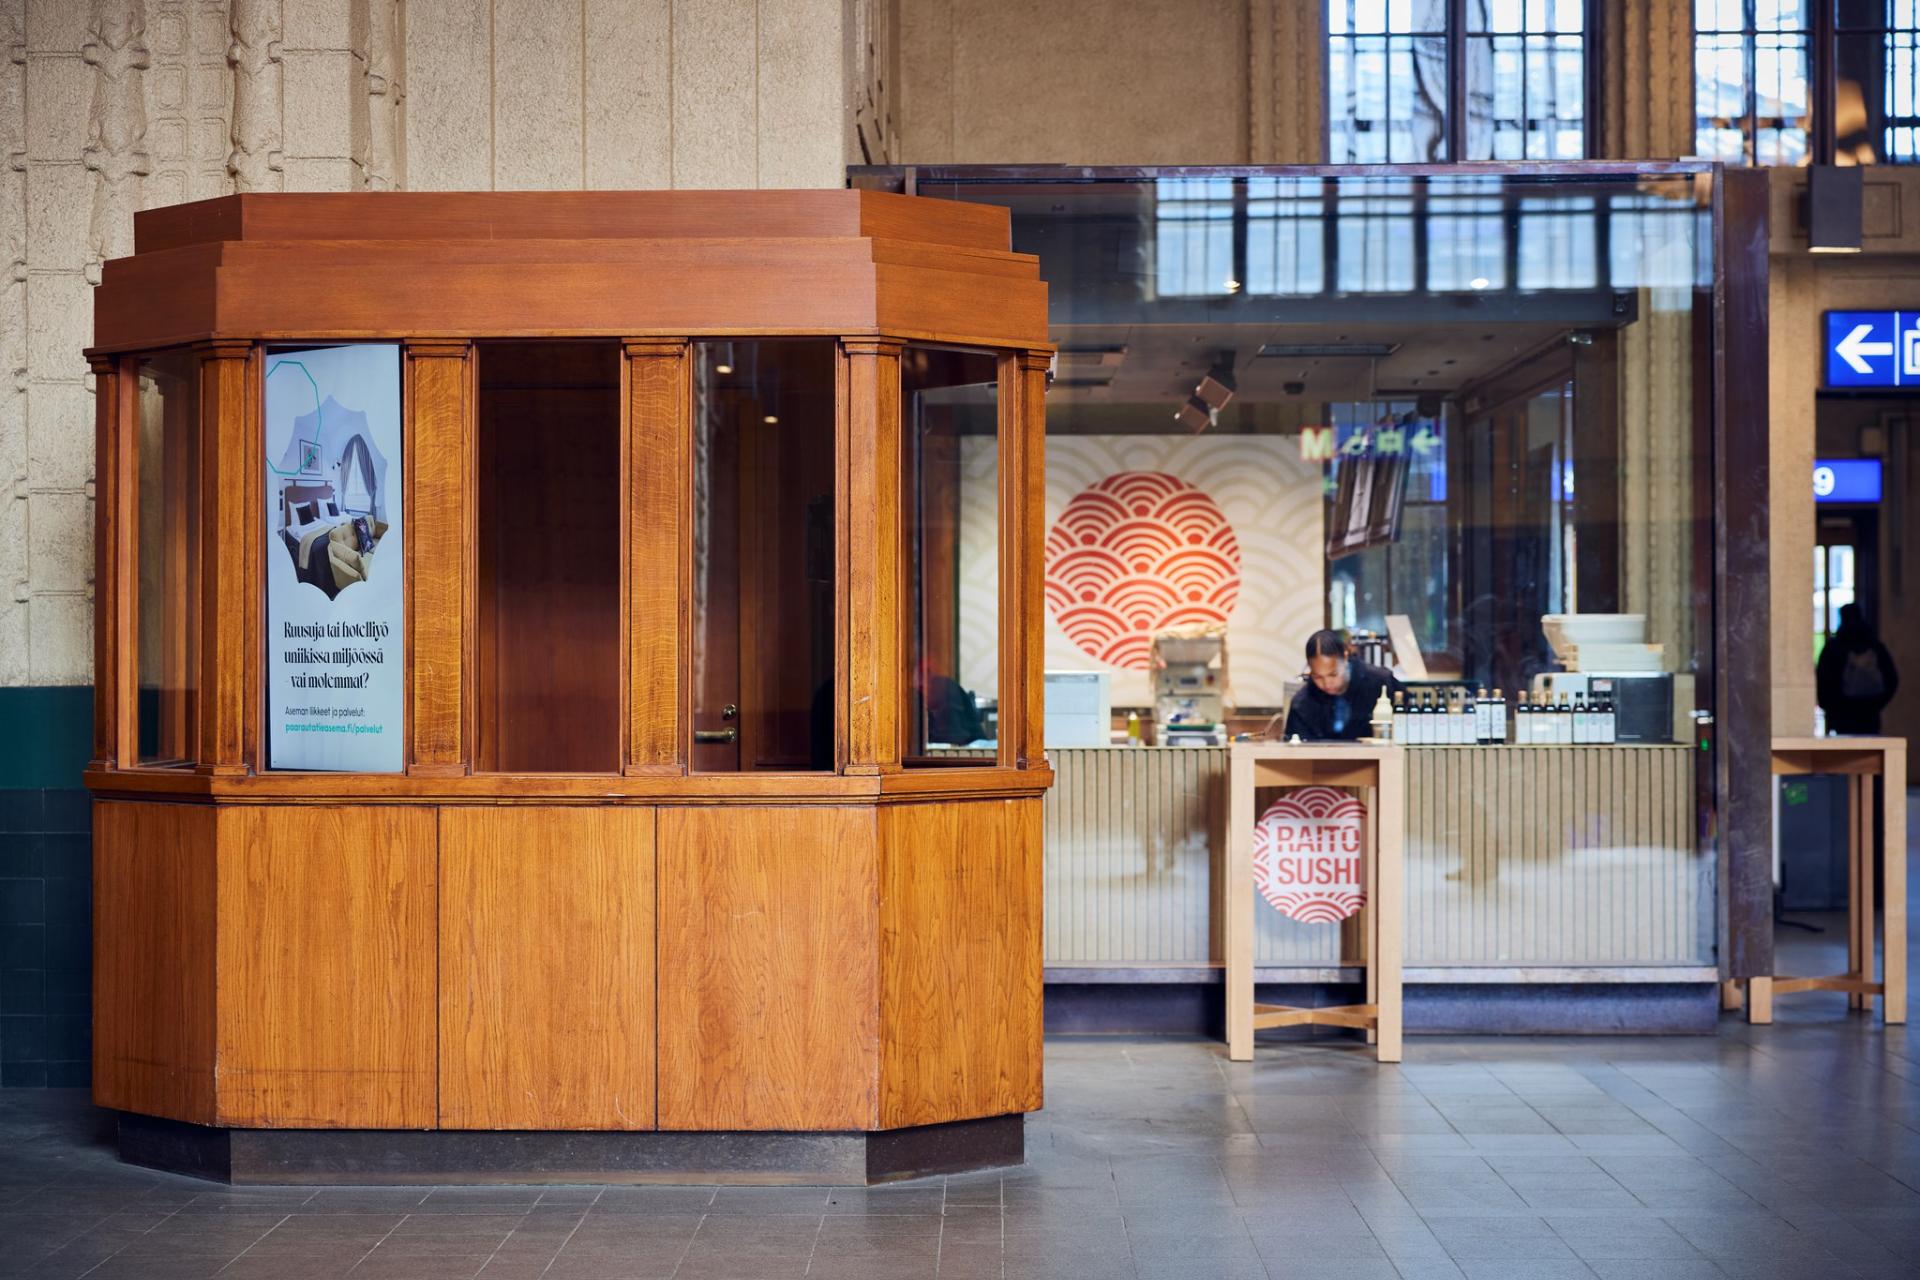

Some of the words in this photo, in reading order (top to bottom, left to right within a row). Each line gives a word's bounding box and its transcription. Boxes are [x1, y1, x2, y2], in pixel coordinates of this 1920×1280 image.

[1812, 467, 1835, 496] 9
[284, 621, 325, 641] Ruusuja
[327, 621, 340, 638] tai
[342, 621, 389, 642] hotelliyö
[284, 648, 330, 663] uniikissa
[333, 648, 384, 667] miljöössä
[291, 672, 306, 688] vai
[308, 672, 369, 689] molemmat?
[285, 706, 309, 716] Aseman
[309, 707, 331, 716] liikkeet
[331, 707, 338, 718] ja
[1277, 825, 1360, 852] RAITO
[1277, 857, 1360, 885] SUSHI
